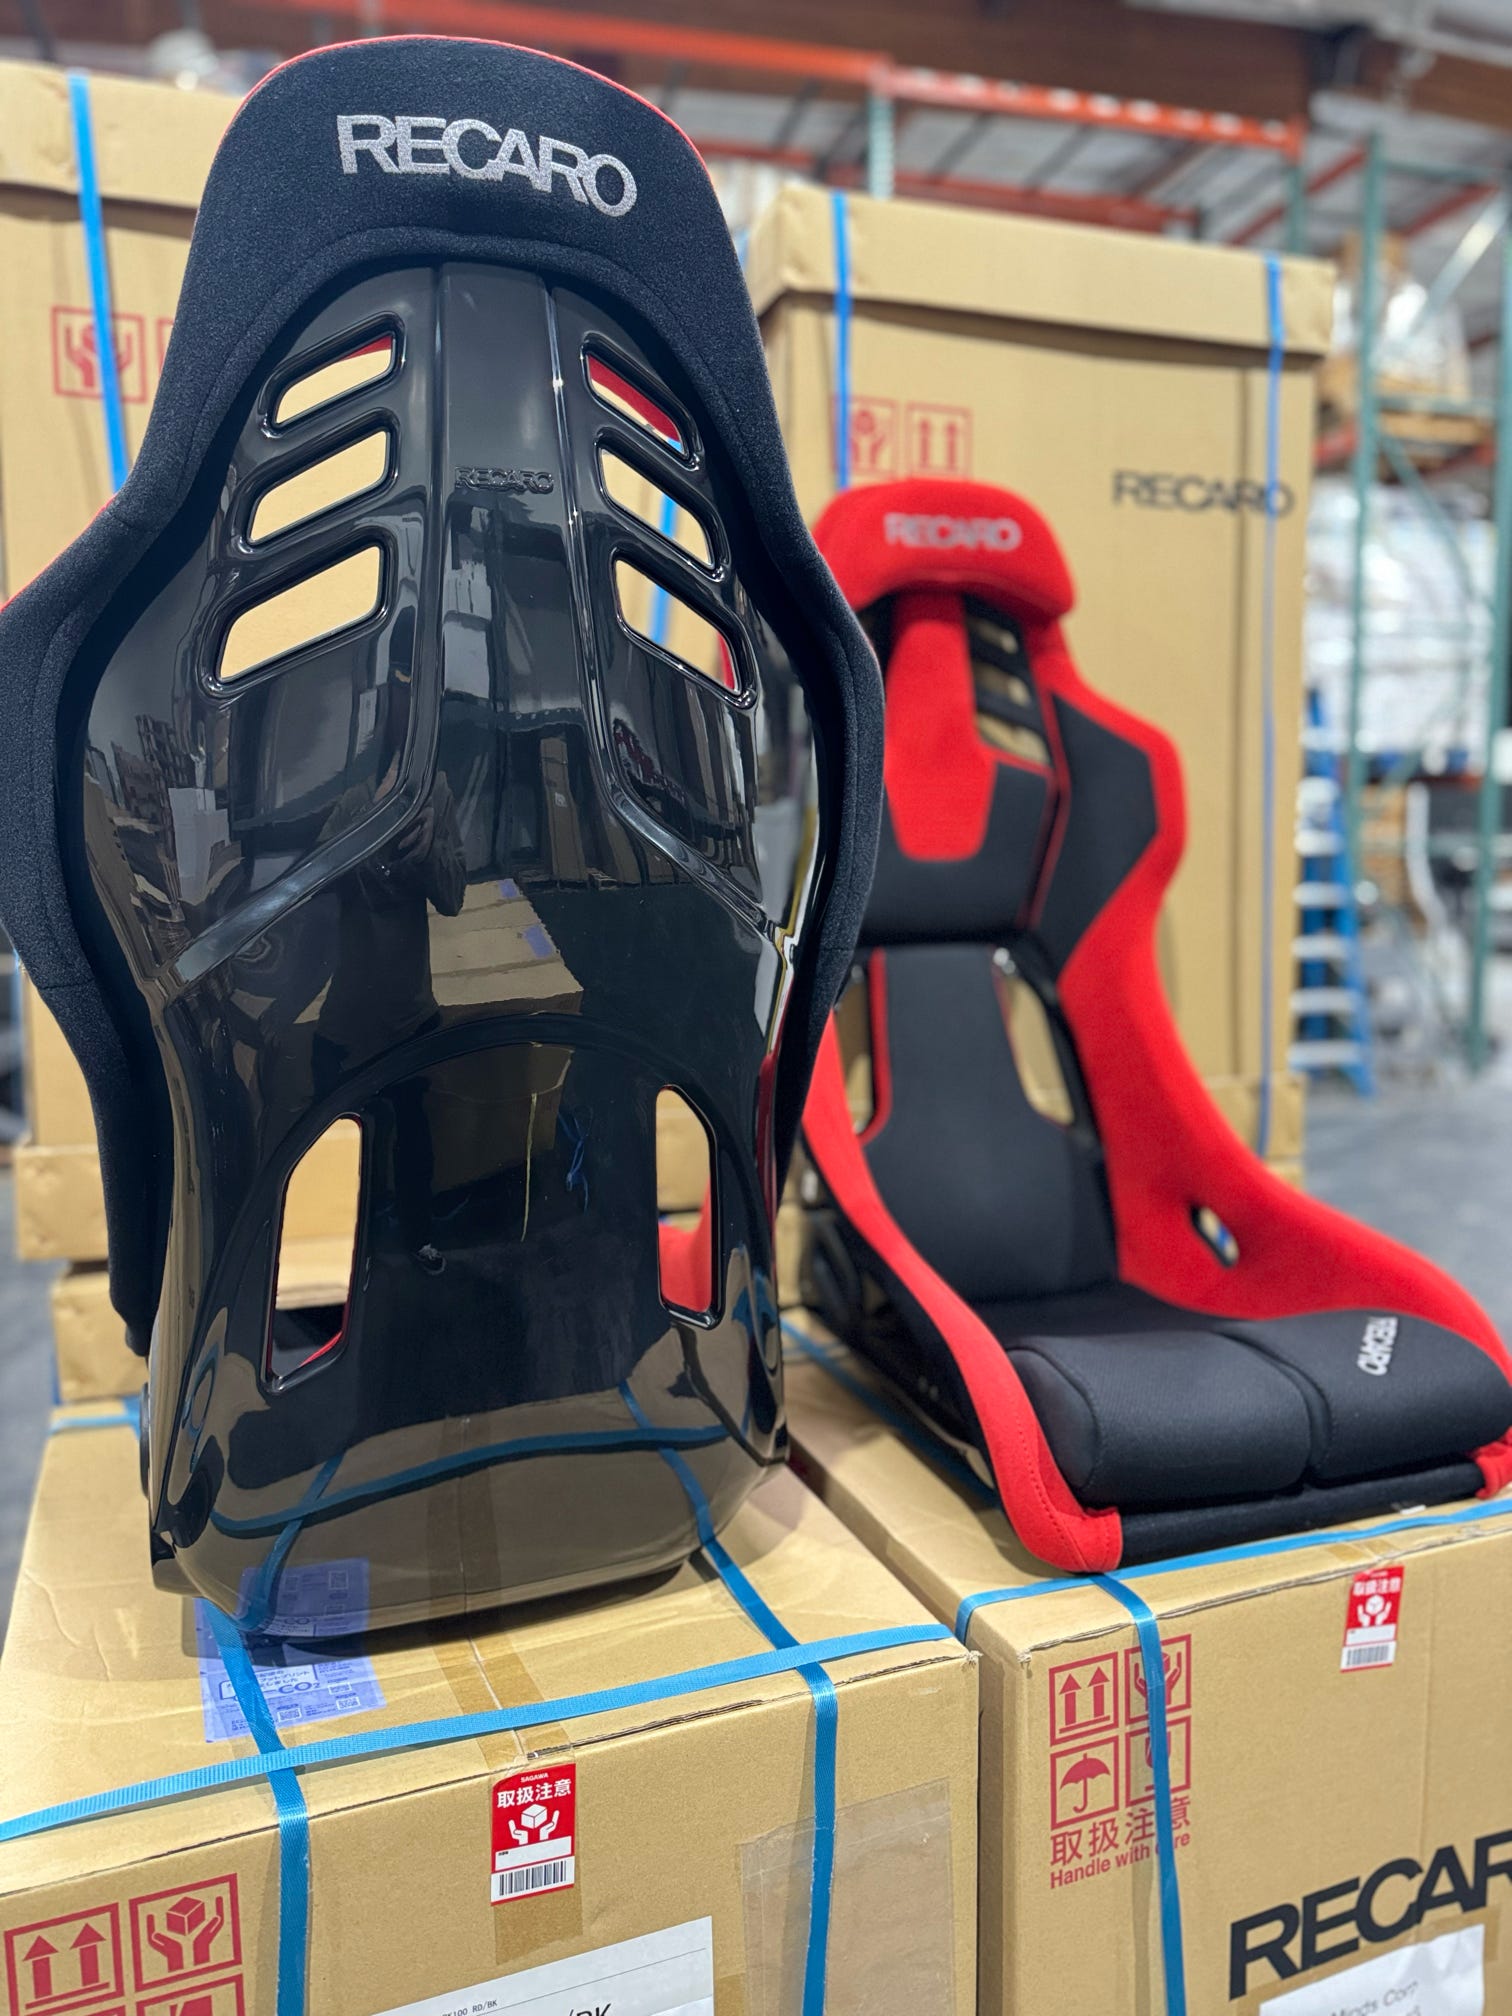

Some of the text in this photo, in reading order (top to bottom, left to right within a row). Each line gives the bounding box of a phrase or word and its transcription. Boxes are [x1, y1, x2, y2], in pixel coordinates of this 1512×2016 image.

[336, 115, 638, 218] RECARO
[455, 467, 554, 494] RECARO
[1111, 470, 1296, 520] RECARO
[883, 512, 1022, 552] RECARO
[1357, 1316, 1398, 1376] RECARO
[496, 1779, 572, 1808] 取扱注意
[520, 1772, 549, 1783] SAGAWA
[1050, 1857, 1111, 1889] Handle
[1115, 1843, 1150, 1868] with
[472, 2000, 497, 2013] RD/BK
